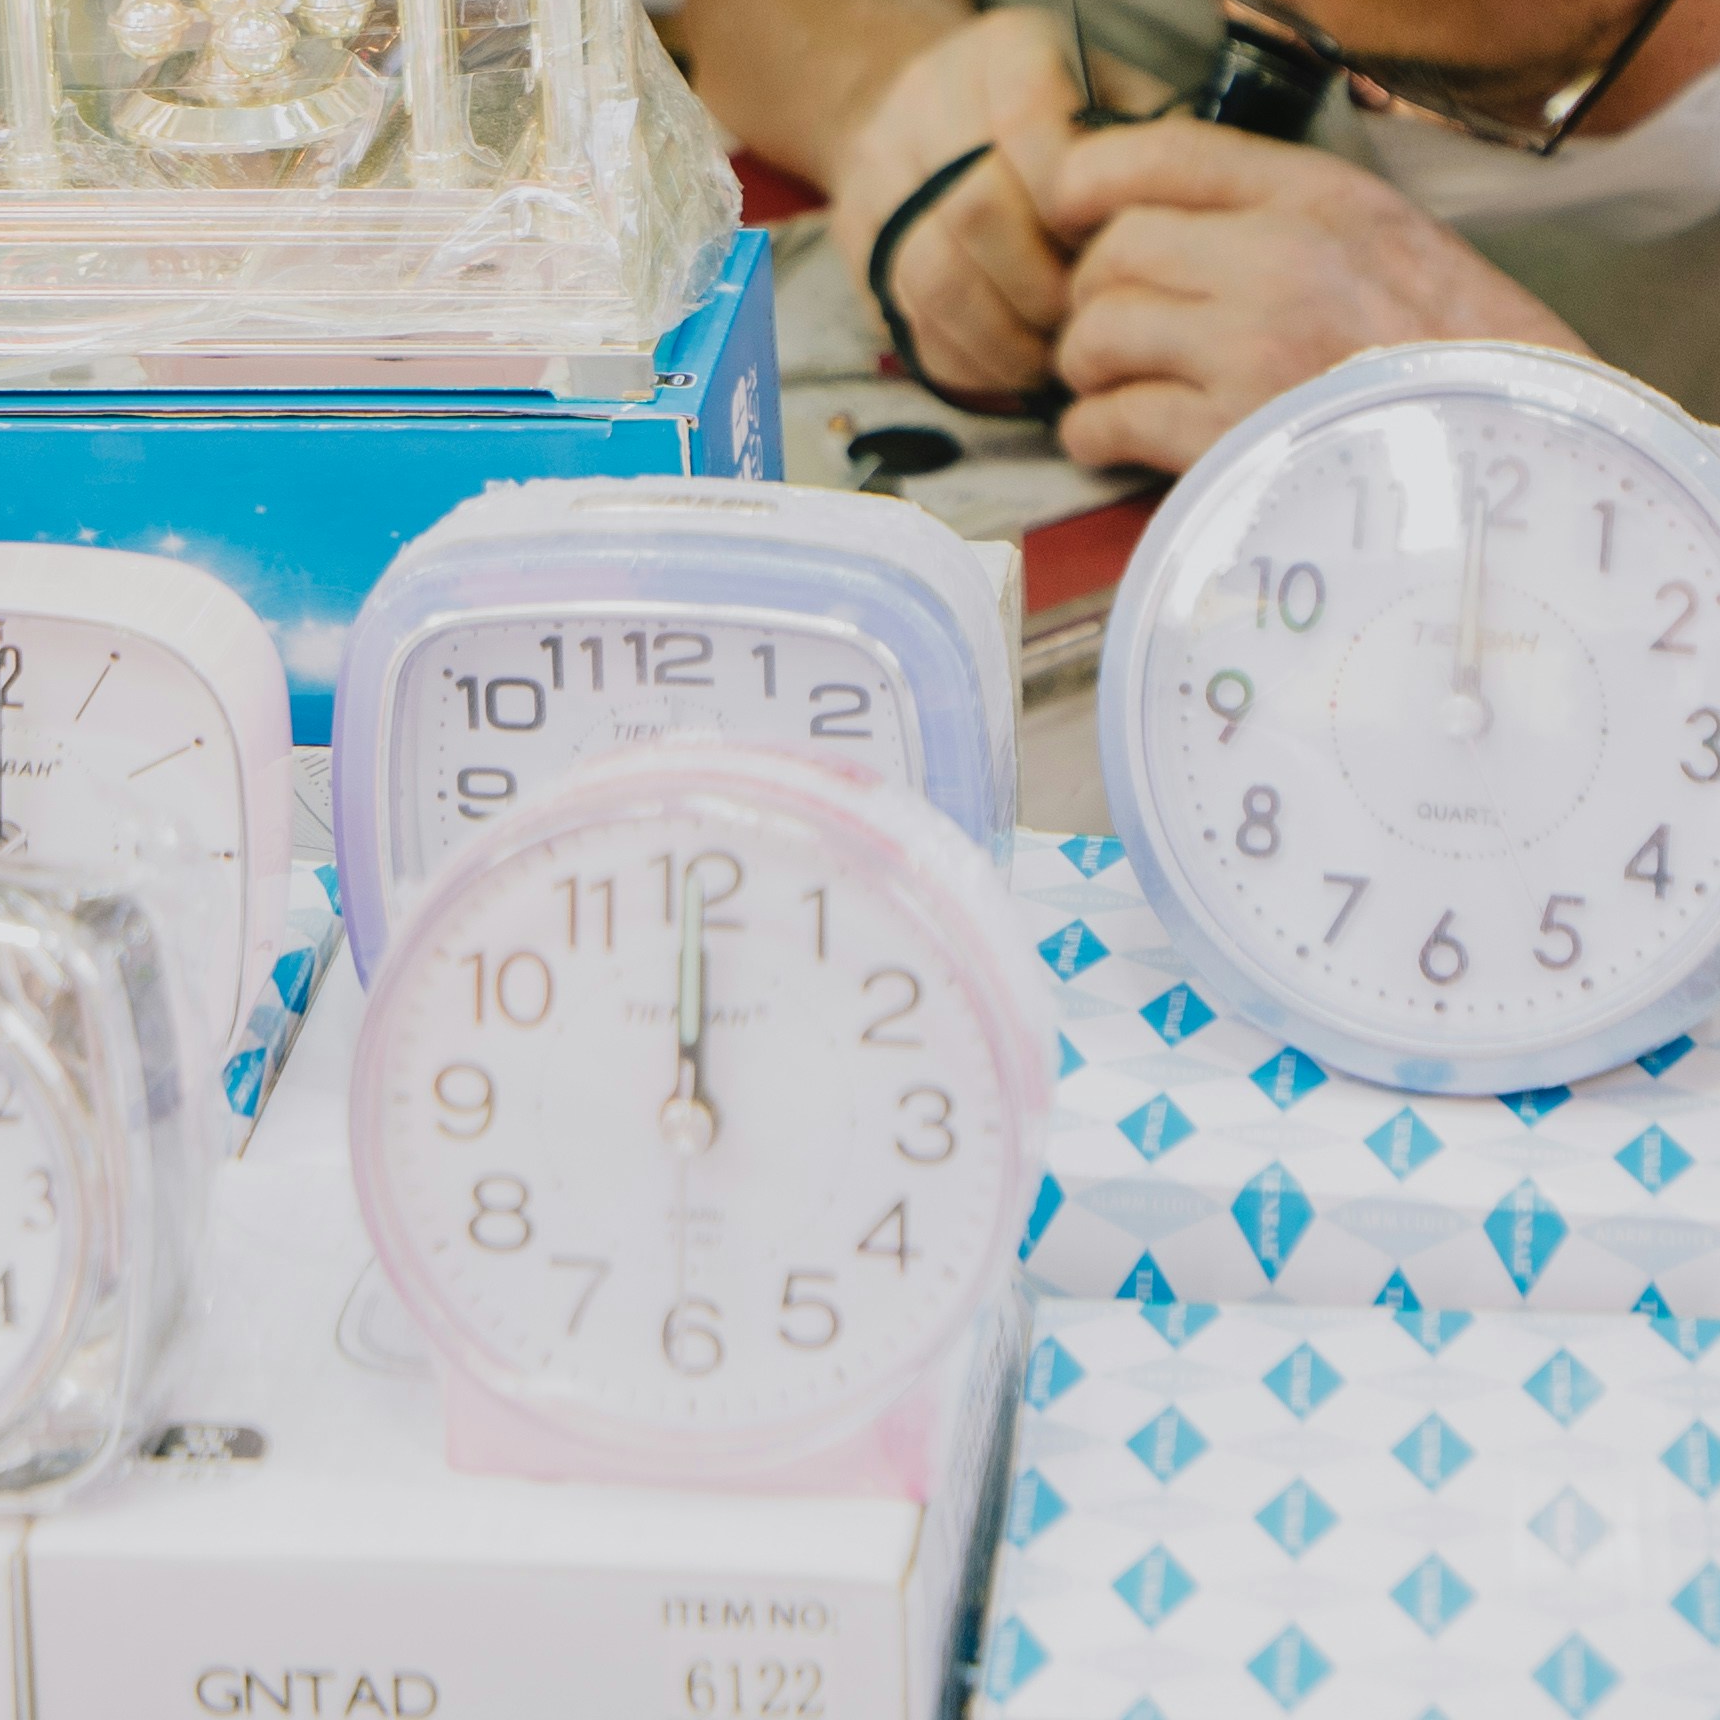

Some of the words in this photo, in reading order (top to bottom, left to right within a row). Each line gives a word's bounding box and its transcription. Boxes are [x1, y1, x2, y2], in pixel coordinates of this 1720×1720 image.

[1592, 500, 1616, 573] 1
[1250, 557, 1326, 632] 10
[1649, 583, 1699, 655] 2
[541, 634, 604, 692] 11
[623, 631, 715, 687] 12
[752, 645, 777, 698] 1
[456, 675, 546, 733] 10
[809, 683, 873, 739] 2
[1205, 669, 1254, 744] 9
[1235, 785, 1280, 858] 8
[1623, 823, 1674, 899] 4
[554, 876, 616, 952] 11
[1323, 872, 1371, 945] 7
[1533, 896, 1585, 970] 5
[1418, 910, 1469, 984] 6
[464, 951, 553, 1027] 10
[860, 968, 923, 1047] 2
[433, 1064, 493, 1140] 9
[895, 1087, 956, 1165] 3
[469, 1177, 532, 1252] 8
[856, 1198, 921, 1272] 4
[662, 1299, 722, 1377] 6
[779, 1271, 839, 1350] 5
[661, 1599, 755, 1630] ITEM
[194, 1669, 439, 1718] GNTAD
[685, 1661, 825, 1718] 6122
